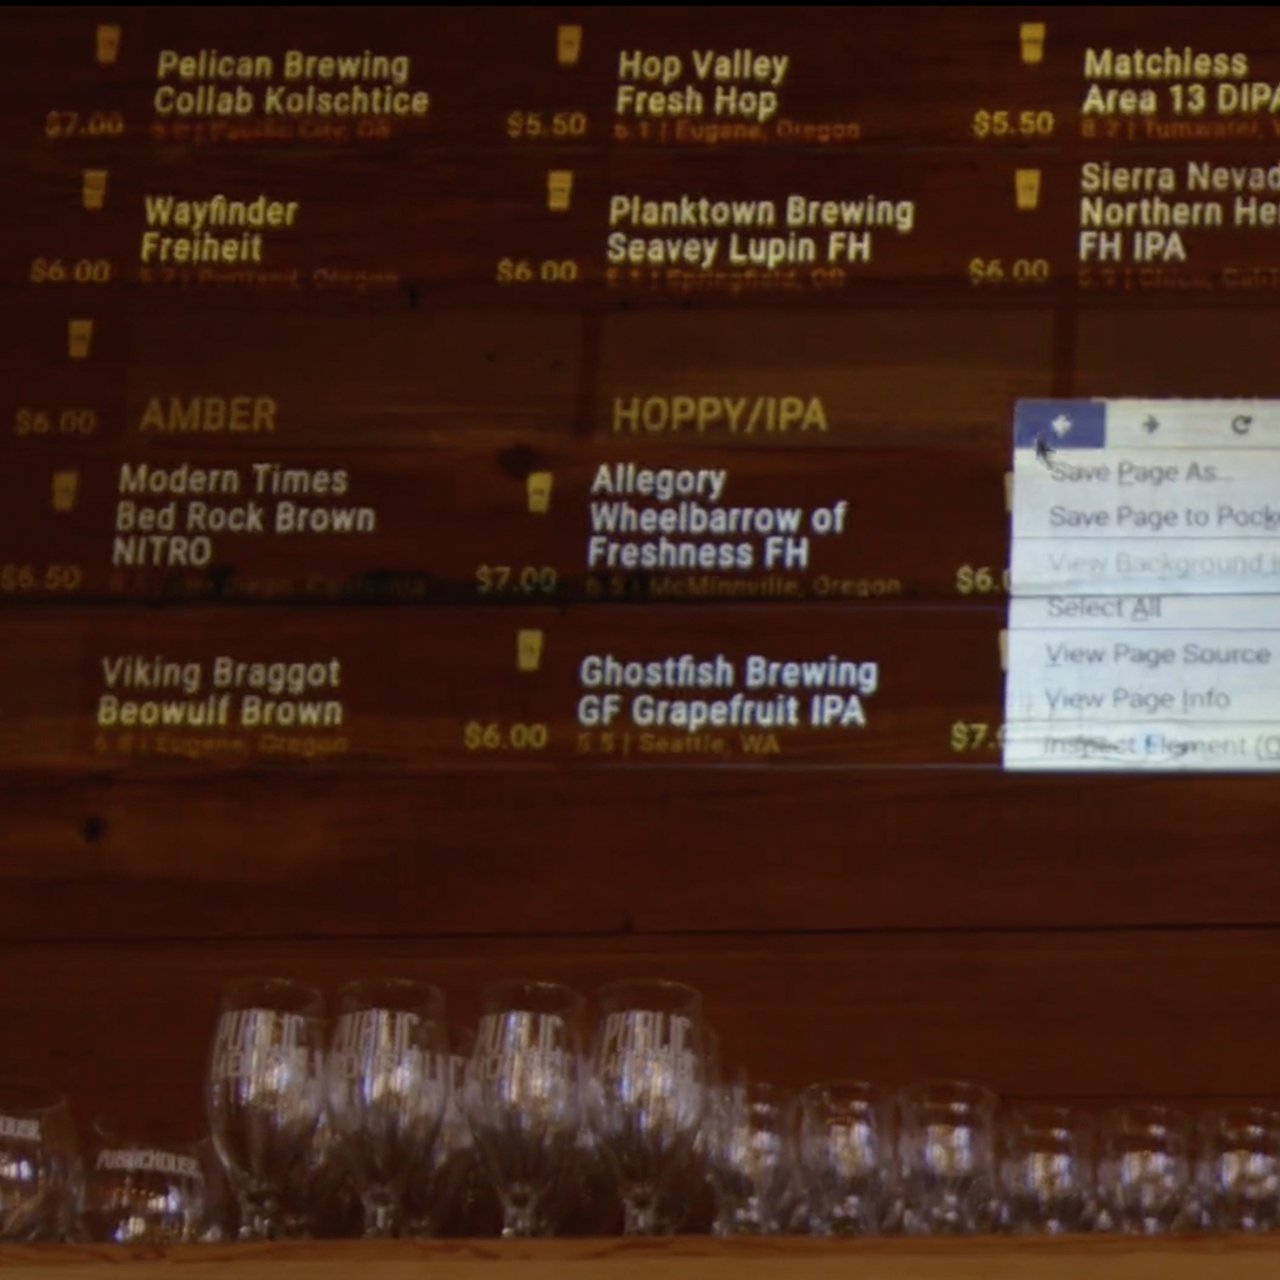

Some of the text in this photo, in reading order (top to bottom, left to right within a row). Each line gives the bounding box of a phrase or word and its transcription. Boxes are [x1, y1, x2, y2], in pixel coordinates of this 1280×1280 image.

[158, 50, 410, 85] Pelican Brewing
[619, 49, 789, 85] Hop Valley
[1083, 47, 1248, 80] Matchless
[154, 85, 431, 117] Collab Kolschtice
[616, 85, 779, 121] Fresh Hop
[1082, 83, 1157, 115] Area
[1170, 83, 1206, 113] 13
[45, 111, 126, 139] $7.00
[507, 112, 587, 139] $5.50
[972, 110, 1055, 138] $5.50
[1081, 162, 1175, 192] Sierra
[144, 195, 299, 232] Wayfinder
[608, 196, 915, 234] Planktown Brewing
[1080, 197, 1222, 228] Northern
[141, 232, 262, 264] Freiheit
[607, 232, 872, 270] Seavey Lupin FH
[1079, 233, 1187, 263] FH IPA
[31, 258, 111, 284] $6.00
[497, 259, 578, 285] $6.00
[968, 259, 1050, 285] $6.00
[13, 408, 95, 435] $6.00
[139, 395, 279, 432] AMBER
[612, 395, 828, 433] HOPPY/IPA
[119, 463, 349, 495] Modern Times
[590, 463, 727, 500] Allegory
[1050, 462, 1109, 484] Save
[1117, 462, 1178, 487] Page
[115, 501, 376, 533] Bed Rock Brown
[590, 500, 849, 534] Wheelbarrow of
[1049, 506, 1108, 528] Save
[1116, 506, 1178, 531] Page
[1186, 506, 1210, 527] to
[112, 536, 212, 567] NITRO
[588, 536, 809, 570] Freshness FH
[1047, 552, 1108, 574] View
[1115, 552, 1263, 578] Background
[475, 565, 559, 594] $7.00
[1046, 597, 1163, 620] Select All
[1046, 644, 1271, 668] View Page Source
[102, 657, 341, 695] Viking Braggot
[580, 654, 879, 696] Ghostfish Brewing
[97, 695, 344, 727] Beowulf Brown
[577, 693, 866, 733] GF Grapefruit IPA
[1045, 688, 1231, 712] View Page Info
[463, 722, 549, 752] $6.00
[741, 734, 781, 755] WA
